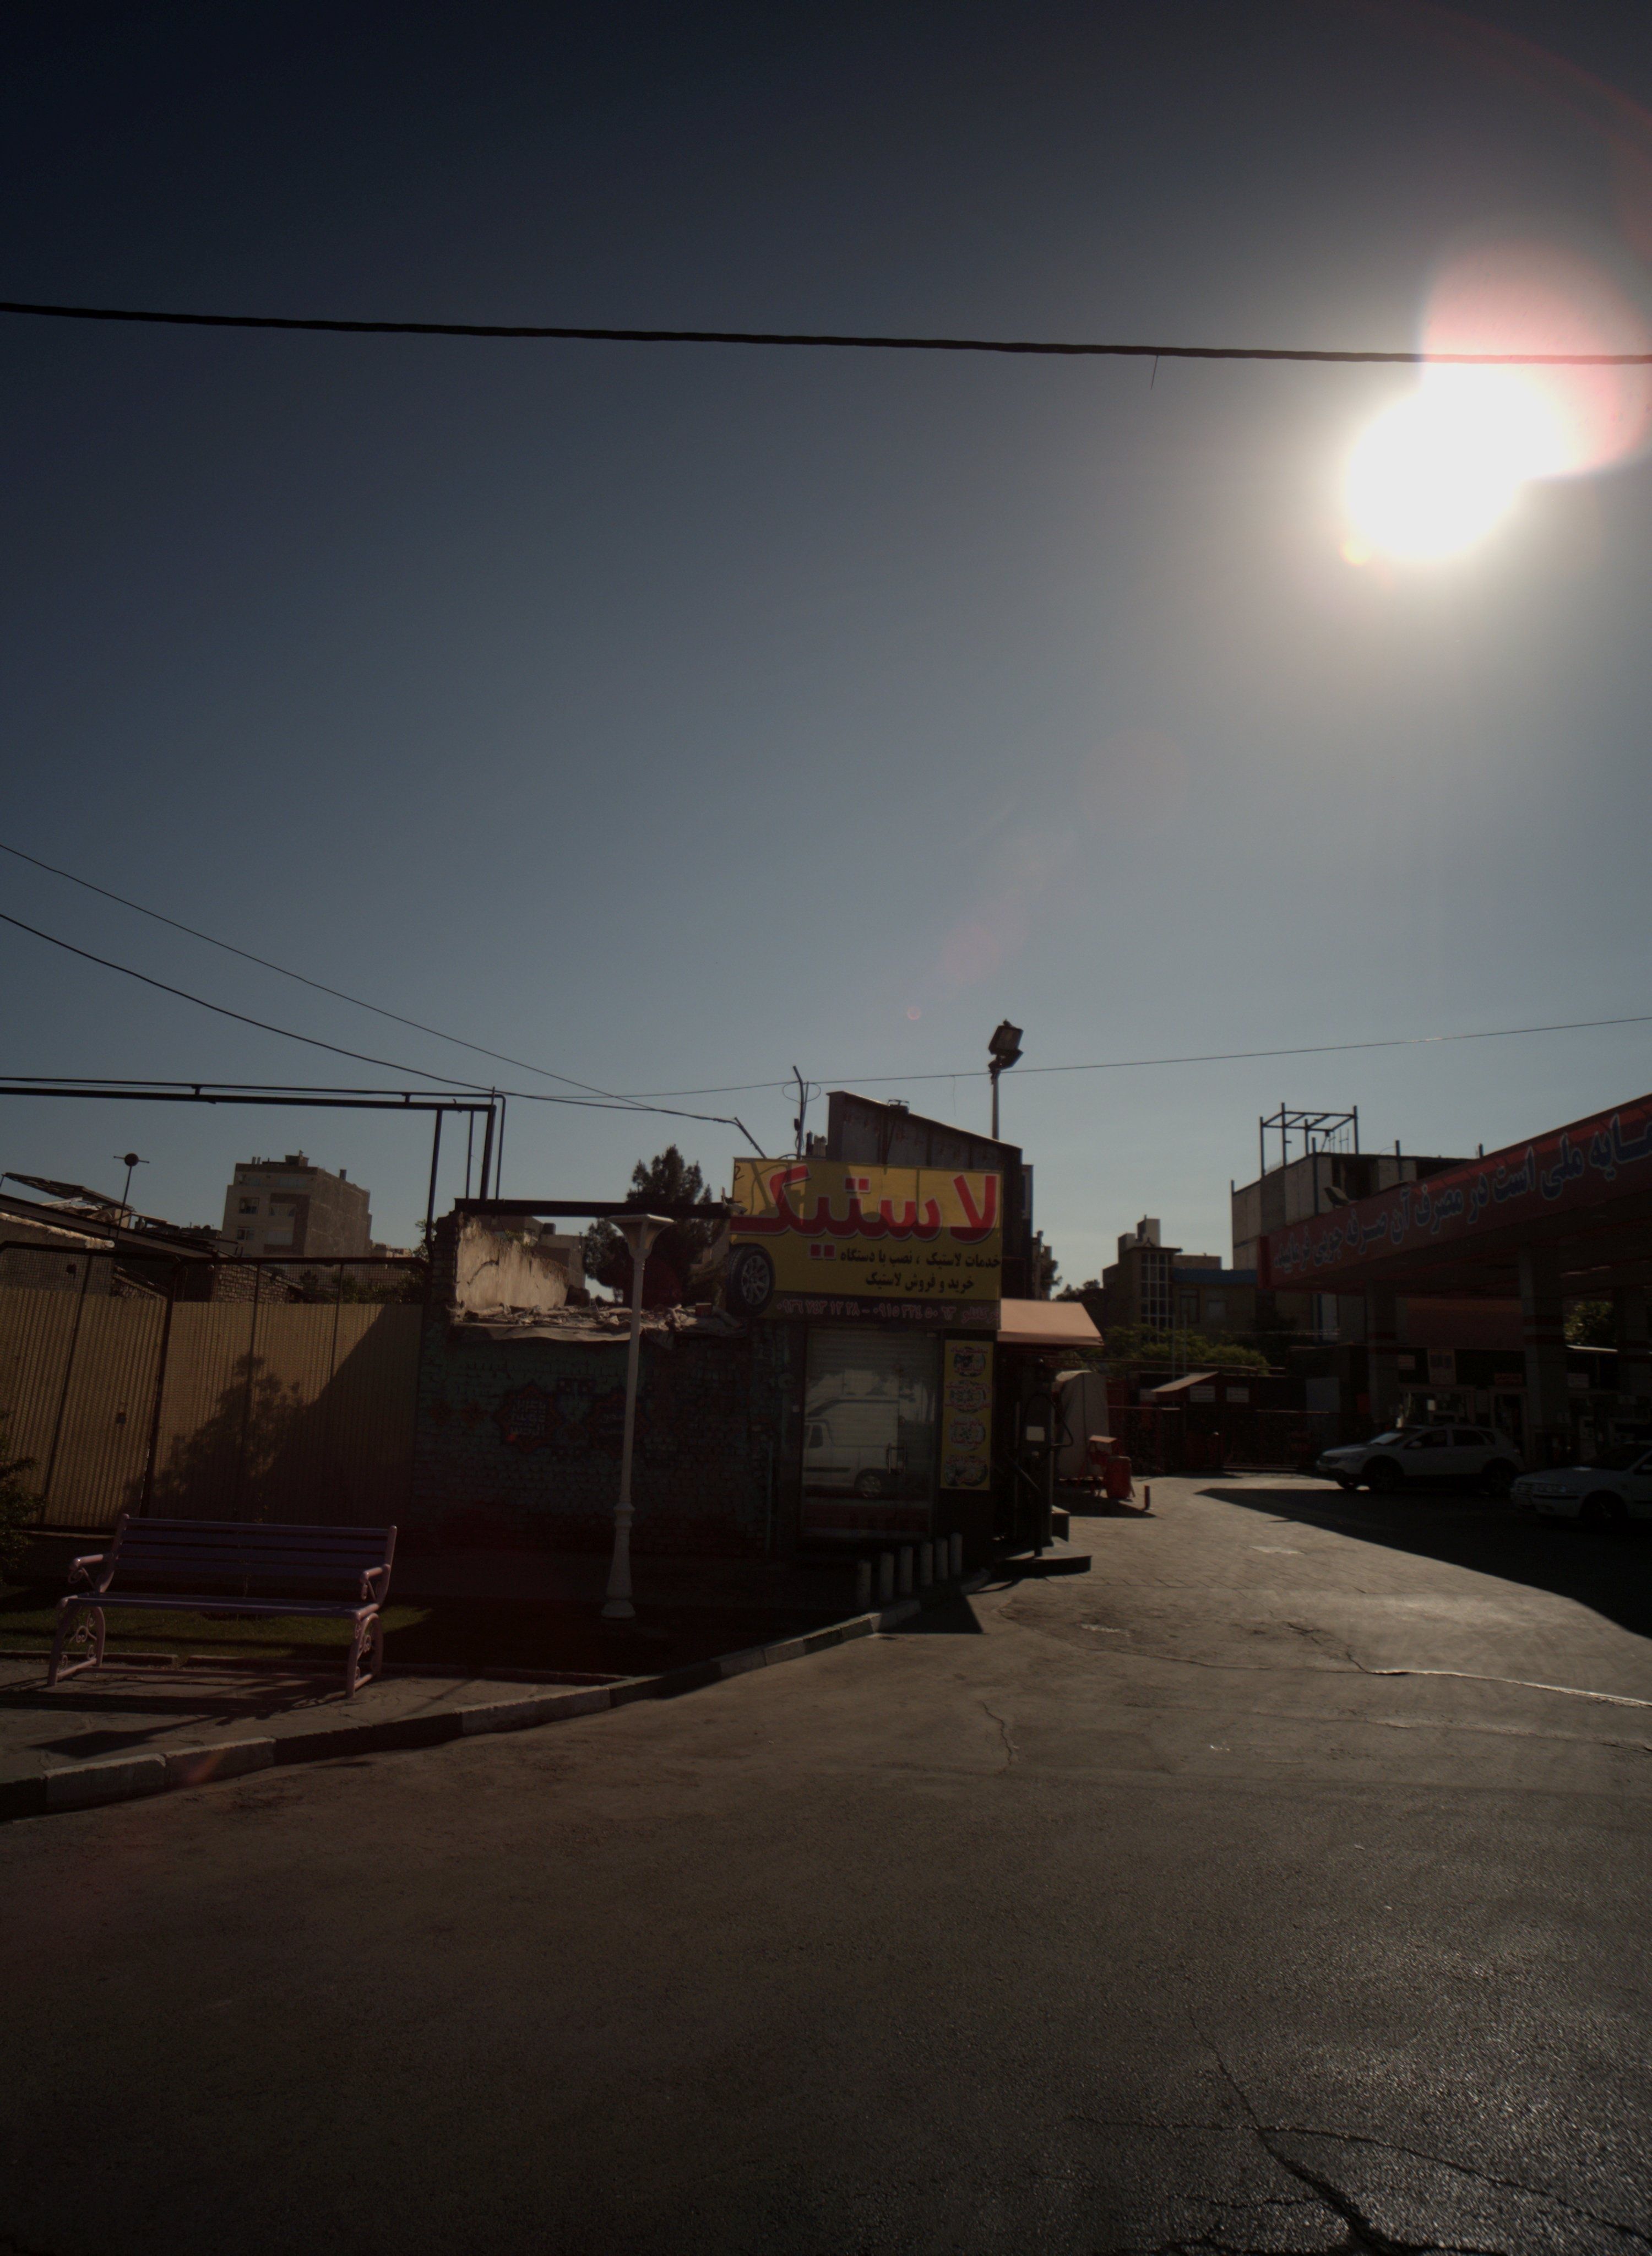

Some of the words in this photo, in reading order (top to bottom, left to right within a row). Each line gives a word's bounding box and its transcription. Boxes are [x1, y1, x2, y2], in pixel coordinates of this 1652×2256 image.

[1492, 1146, 1535, 1202] است
[1541, 1132, 1584, 1201] ملی
[1467, 1172, 1489, 1224] در
[730, 1163, 999, 1261] لاستیک
[1391, 1186, 1411, 1244] آن
[1415, 1184, 1464, 1235] مصرف
[1345, 1208, 1388, 1255] صرفه
[841, 1248, 875, 1262] دستگاه
[878, 1249, 886, 1266] با
[890, 1251, 912, 1266] نصب
[926, 1251, 961, 1269] لاستیک
[966, 1252, 1001, 1268] خدمات
[866, 1271, 901, 1289] لاستیک
[905, 1272, 936, 1293] فروش
[939, 1281, 944, 1293] و
[948, 1276, 974, 1294] خرید
